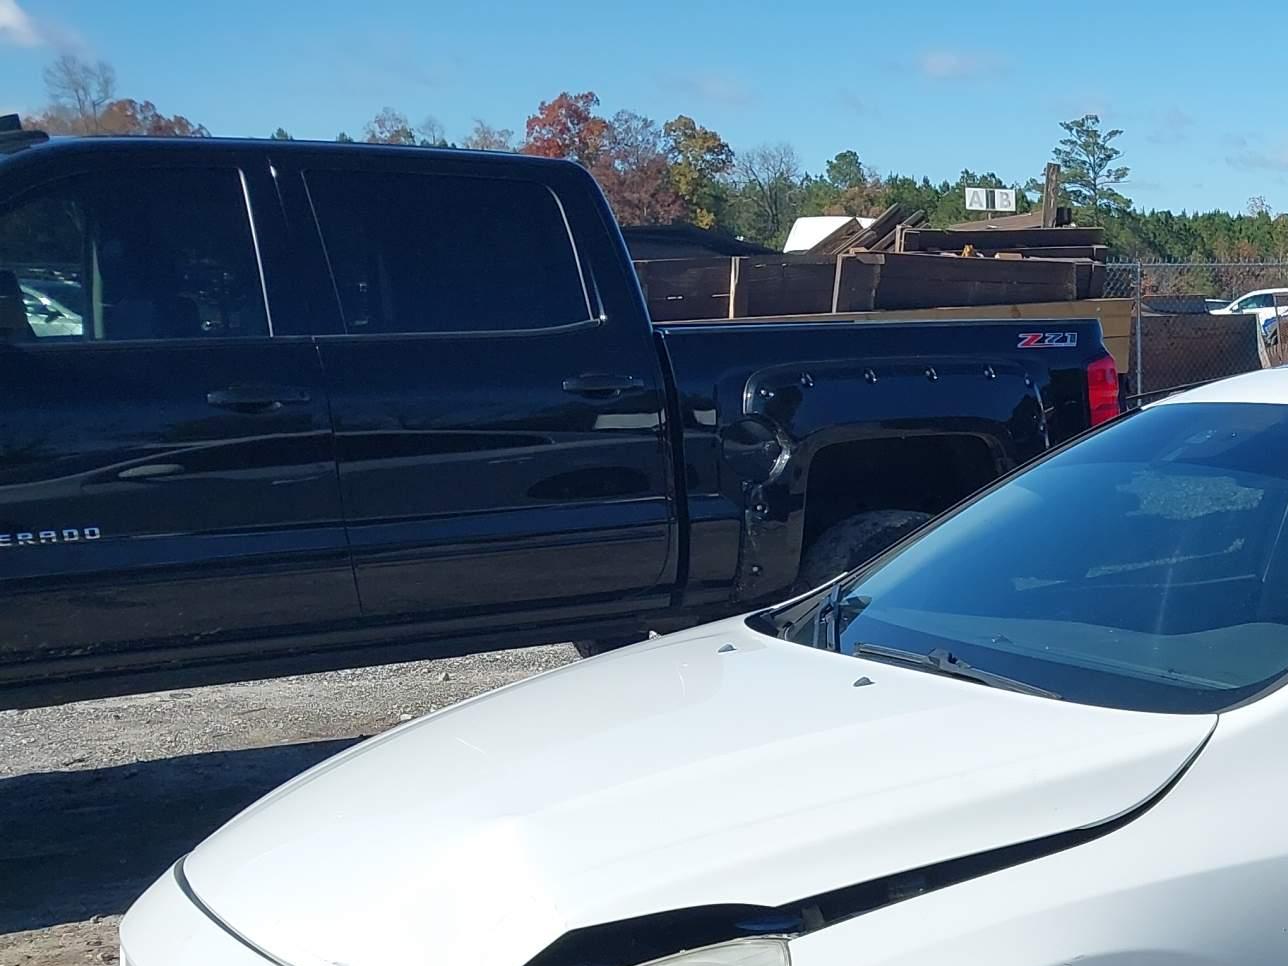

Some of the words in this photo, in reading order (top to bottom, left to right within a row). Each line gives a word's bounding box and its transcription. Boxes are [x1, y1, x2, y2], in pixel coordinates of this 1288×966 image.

[968, 189, 985, 208] A
[999, 190, 1012, 209] B
[1017, 332, 1078, 349] Z71
